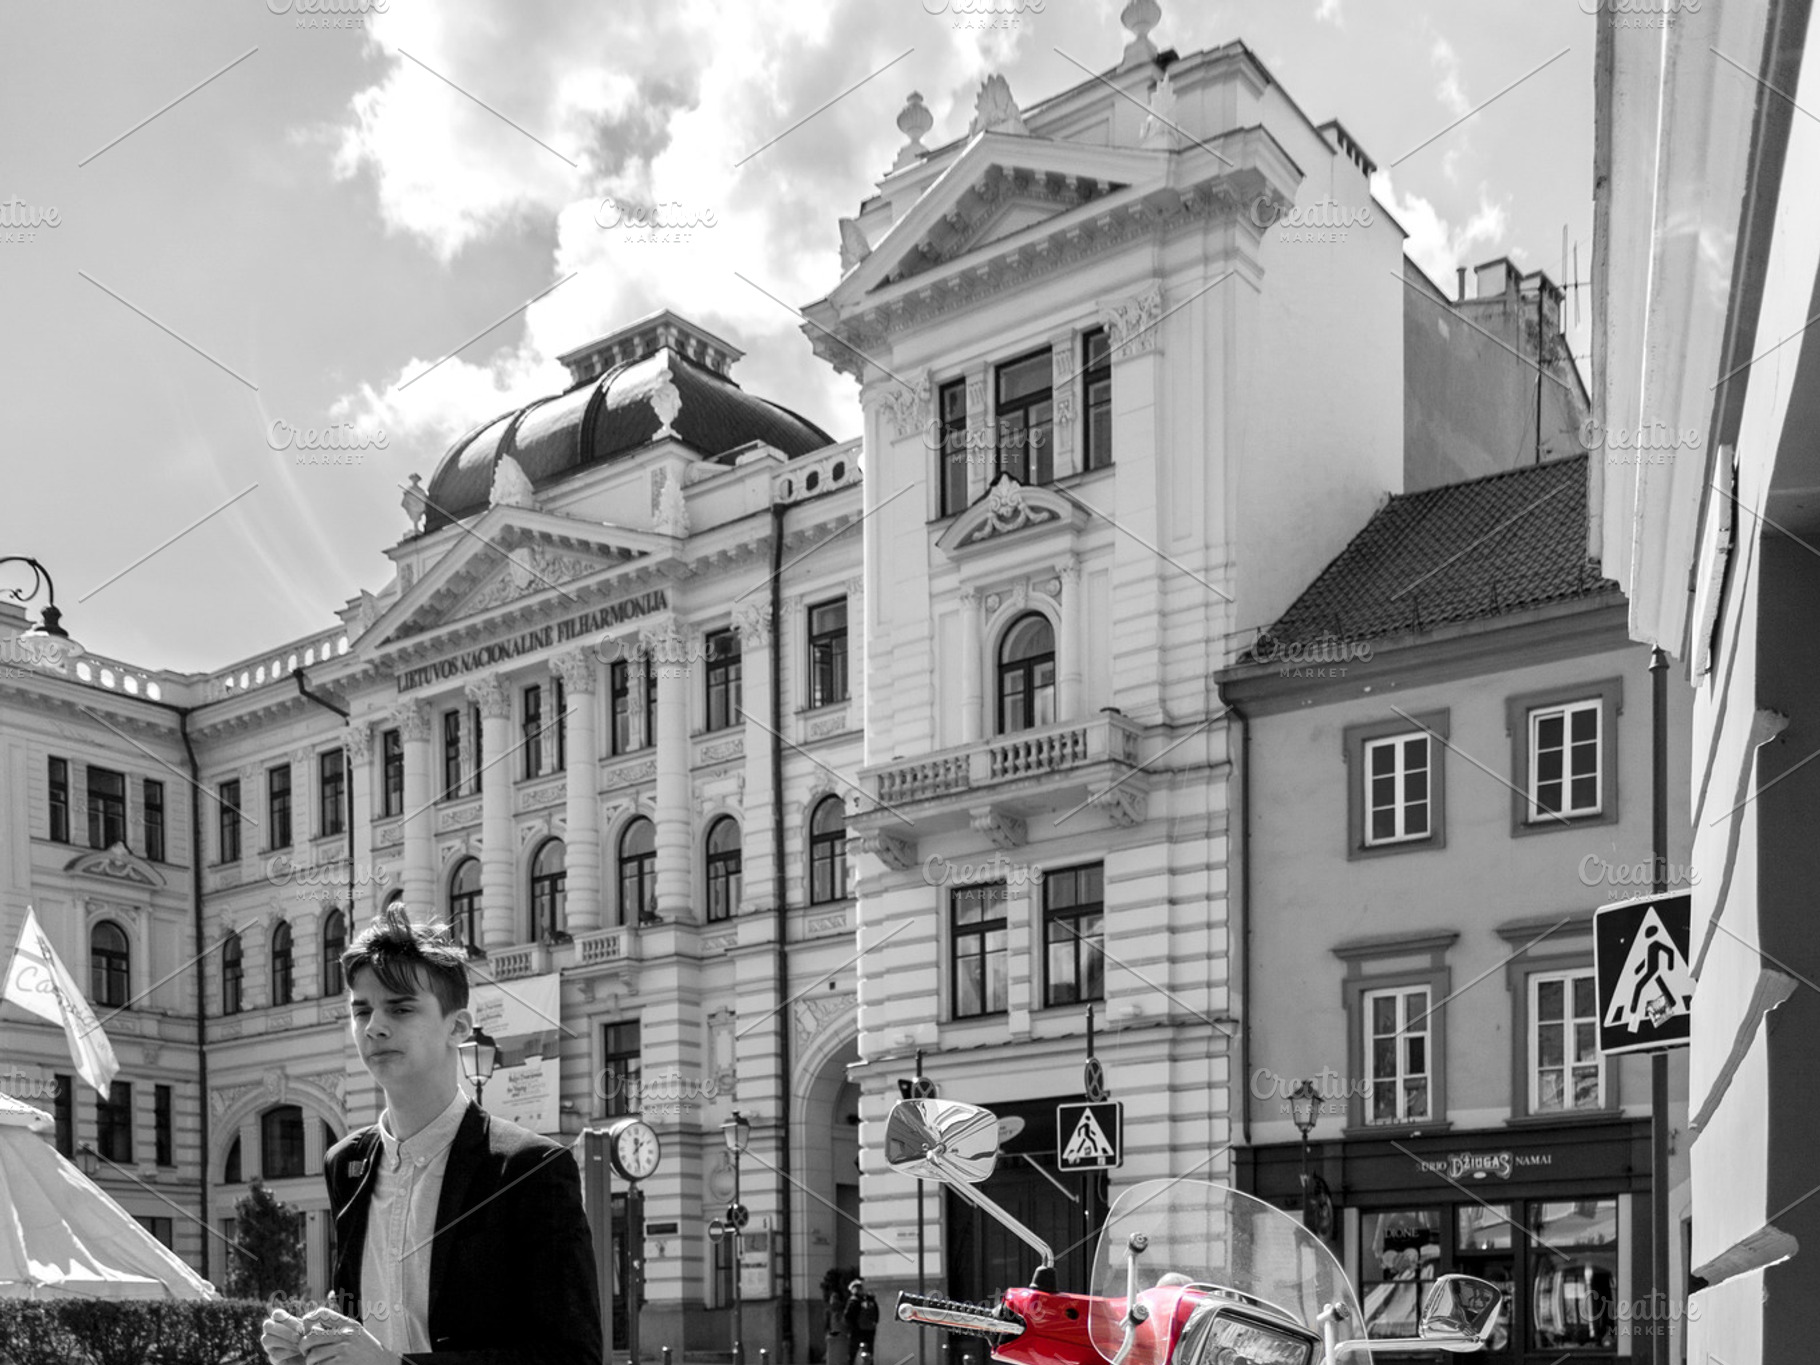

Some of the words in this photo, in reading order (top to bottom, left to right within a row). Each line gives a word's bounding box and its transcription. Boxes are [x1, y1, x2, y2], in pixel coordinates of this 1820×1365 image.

[397, 656, 459, 694] LIETUVOS
[557, 589, 668, 643] FILHARMONIJA
[1515, 1154, 1552, 1166] NAMAI
